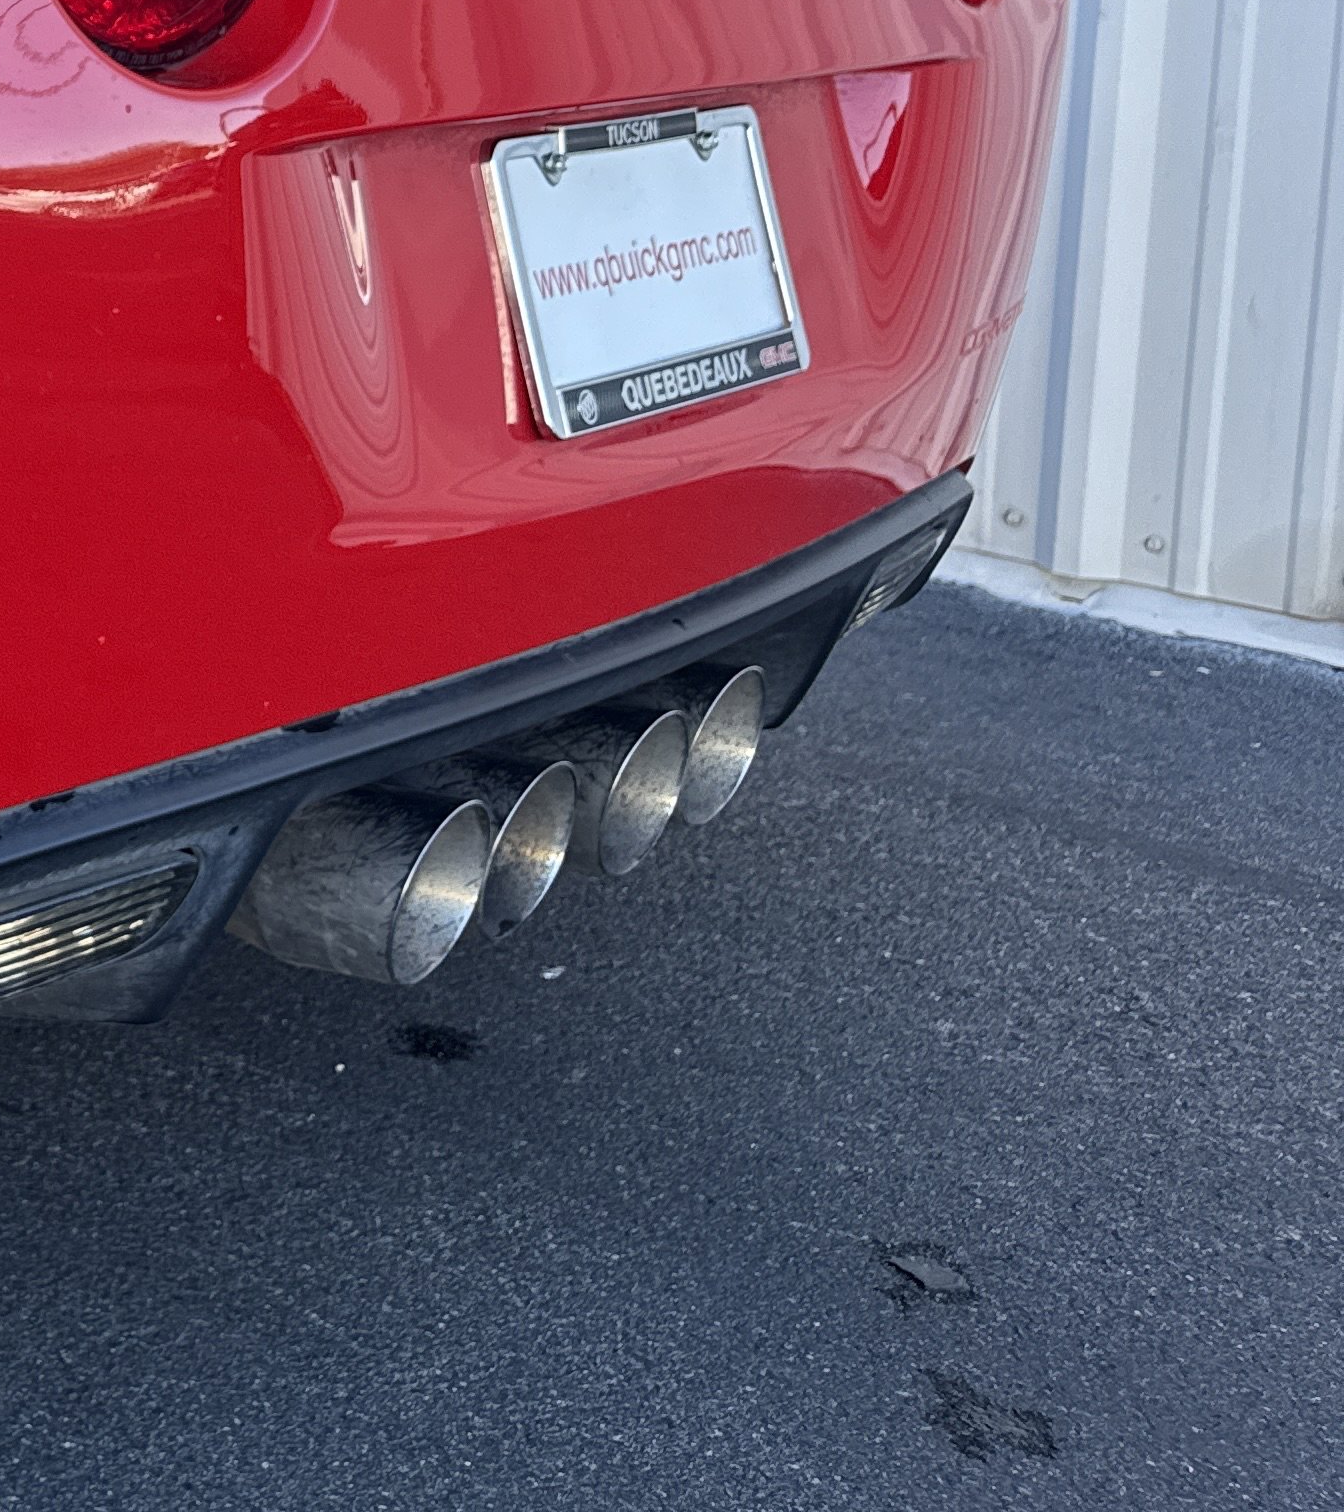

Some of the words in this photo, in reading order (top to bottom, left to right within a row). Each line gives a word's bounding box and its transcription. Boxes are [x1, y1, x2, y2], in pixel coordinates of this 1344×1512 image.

[605, 119, 660, 147] TUCSON
[533, 226, 758, 301] www.qbuickgmc.com
[621, 348, 753, 413] QUEBEDEAUX
[759, 341, 797, 370] GMC
